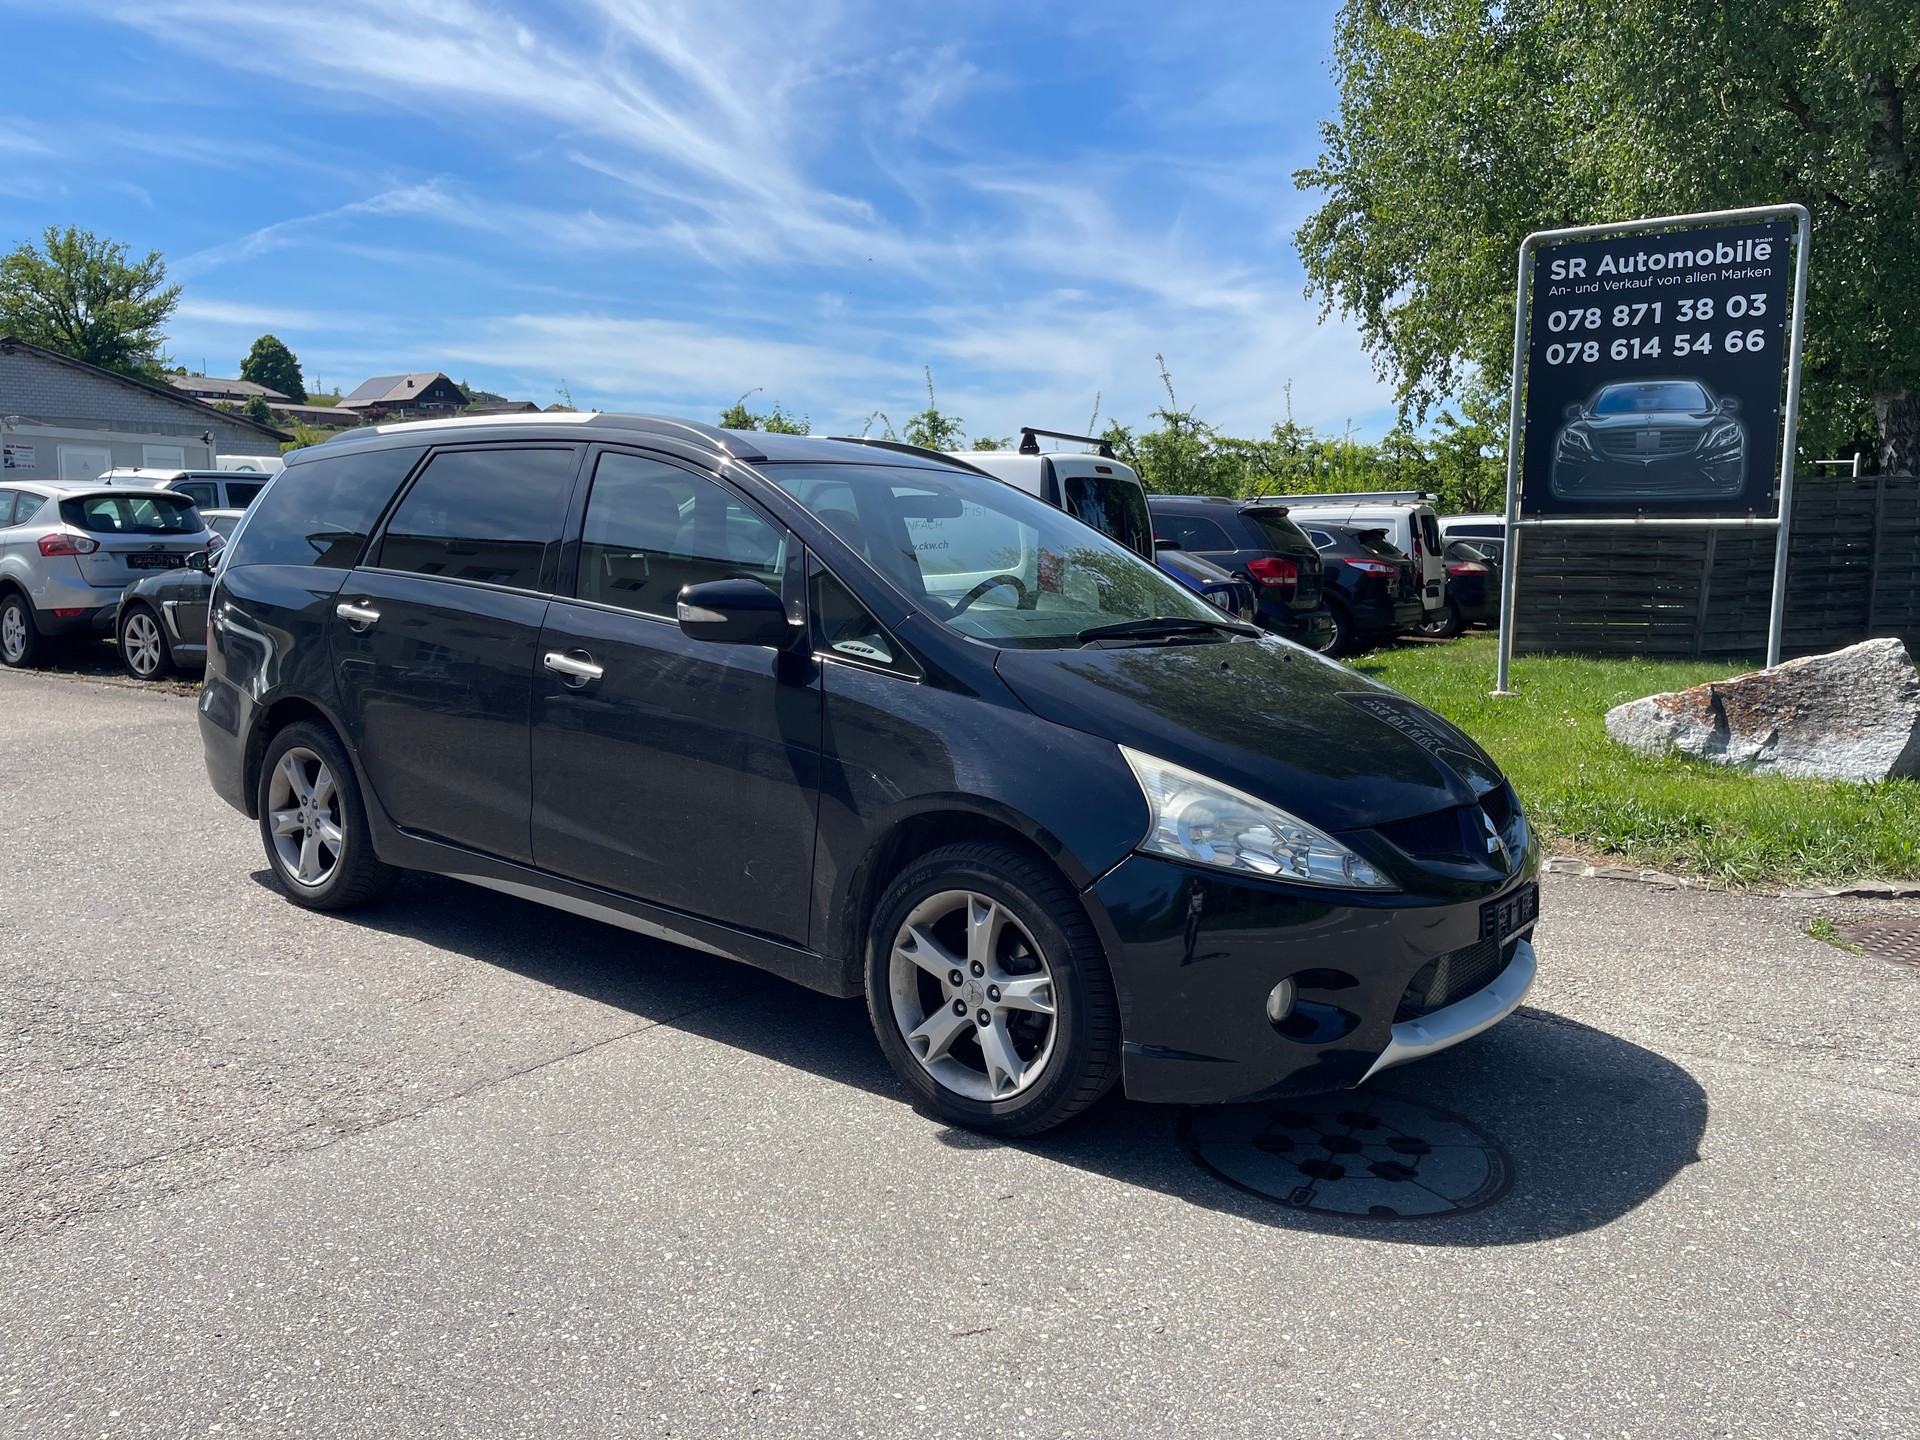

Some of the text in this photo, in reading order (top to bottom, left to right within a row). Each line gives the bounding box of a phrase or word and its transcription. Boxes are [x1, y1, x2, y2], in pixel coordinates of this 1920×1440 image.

[1550, 239, 1772, 280] SR Automobile
[1549, 267, 1771, 296] An- und Verkauf von allen Marken
[1547, 293, 1767, 332] 078 871 38 03
[1546, 328, 1765, 366] 078 614 54 66
[907, 521, 945, 531] NFACH.
